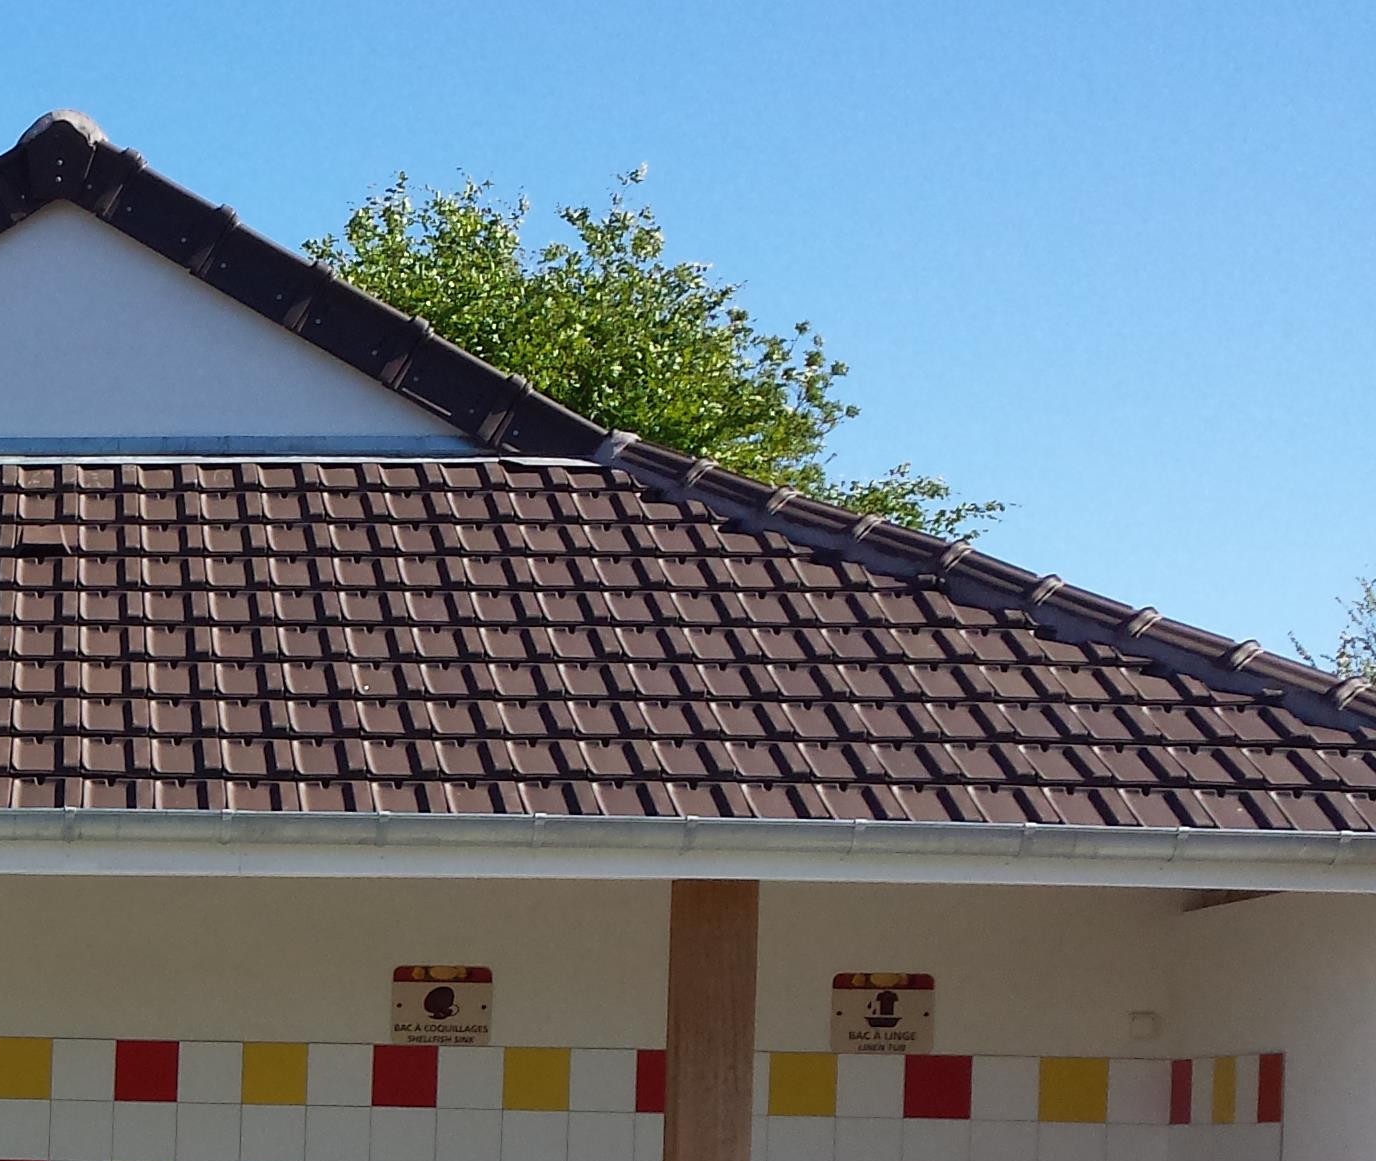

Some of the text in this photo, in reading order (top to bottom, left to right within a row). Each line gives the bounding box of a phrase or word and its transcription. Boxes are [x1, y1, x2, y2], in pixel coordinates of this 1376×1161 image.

[394, 1023, 412, 1032] BAC
[424, 1023, 488, 1033] COQUILLAGES
[848, 1031, 871, 1041] BAC
[884, 1031, 917, 1041] LINGE
